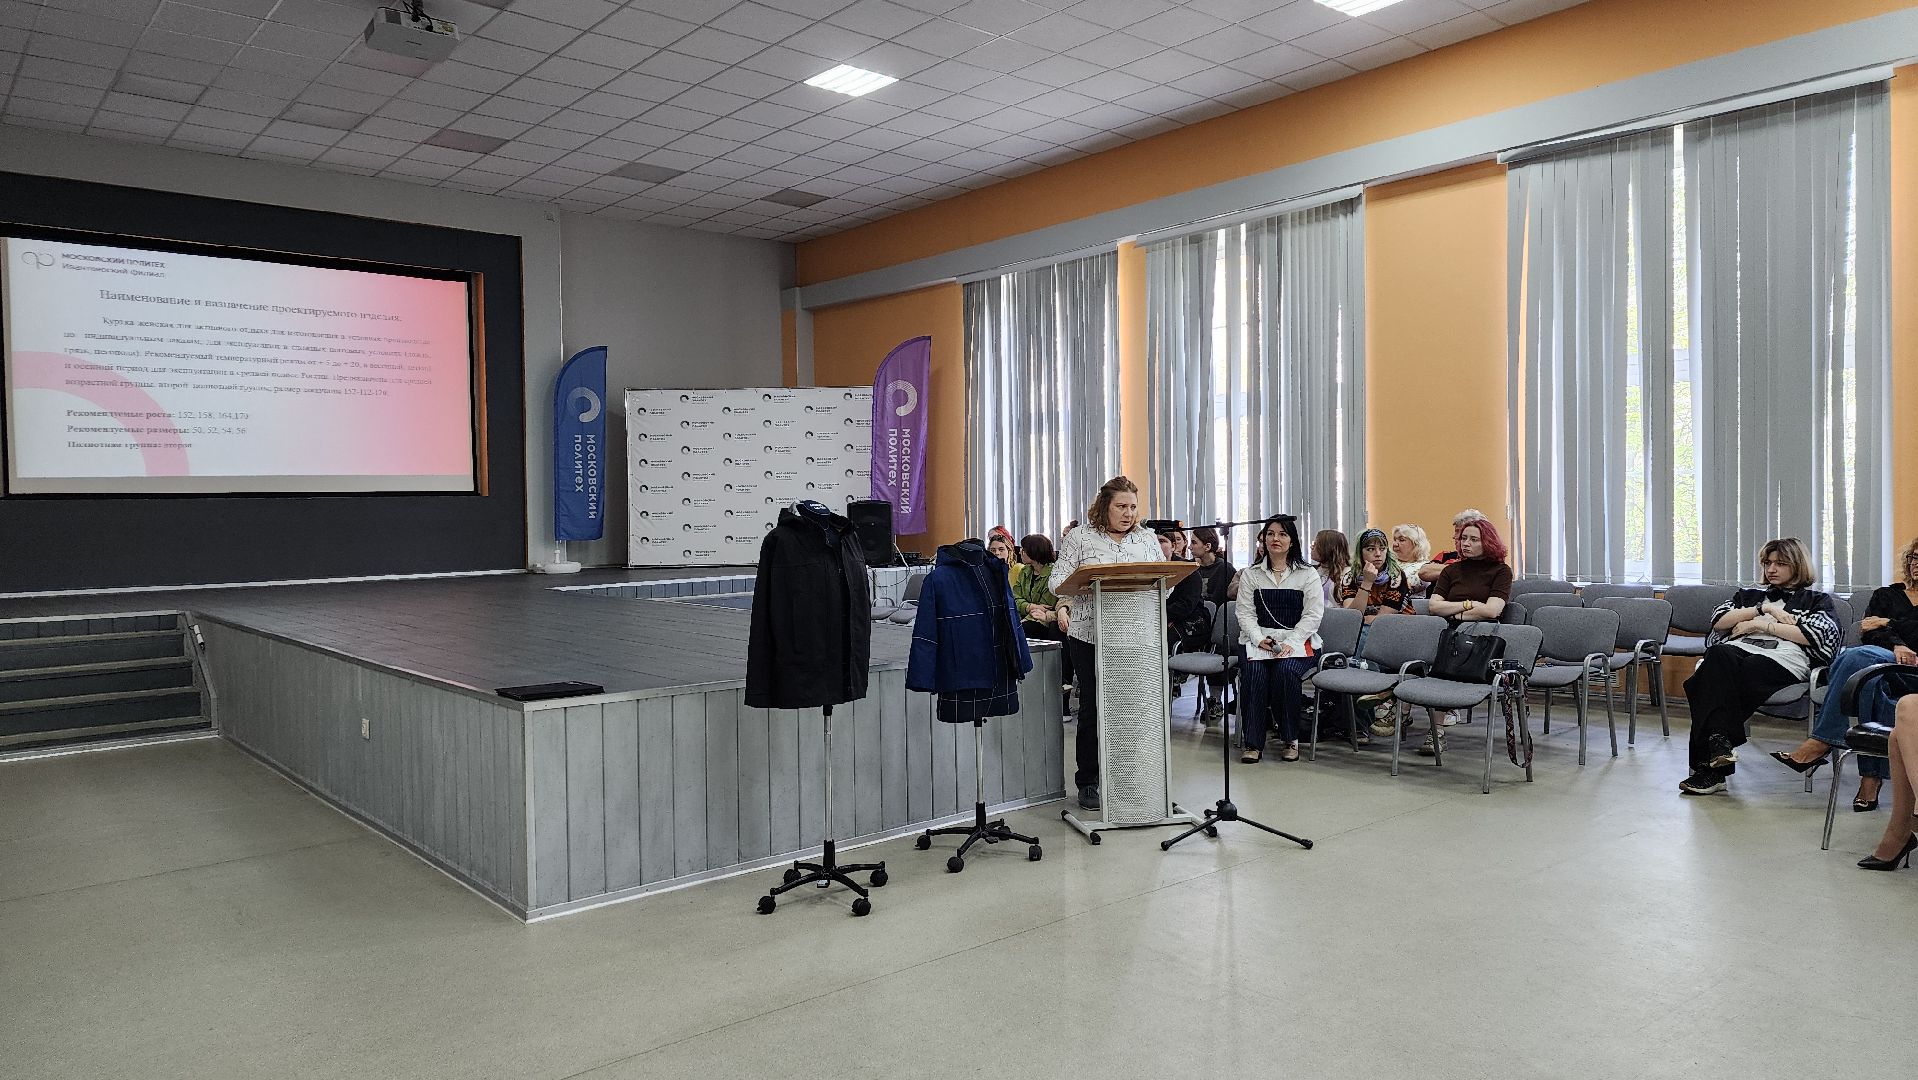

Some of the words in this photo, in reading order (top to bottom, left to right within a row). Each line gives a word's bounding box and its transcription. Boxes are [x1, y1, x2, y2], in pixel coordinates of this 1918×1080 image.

[99, 289, 190, 305] Наименование
[205, 300, 269, 311] назначение
[271, 304, 357, 319] проектируемого
[587, 434, 598, 519] МОСКОВСКИЙ
[900, 428, 912, 514] МОСКОВСКИЙ
